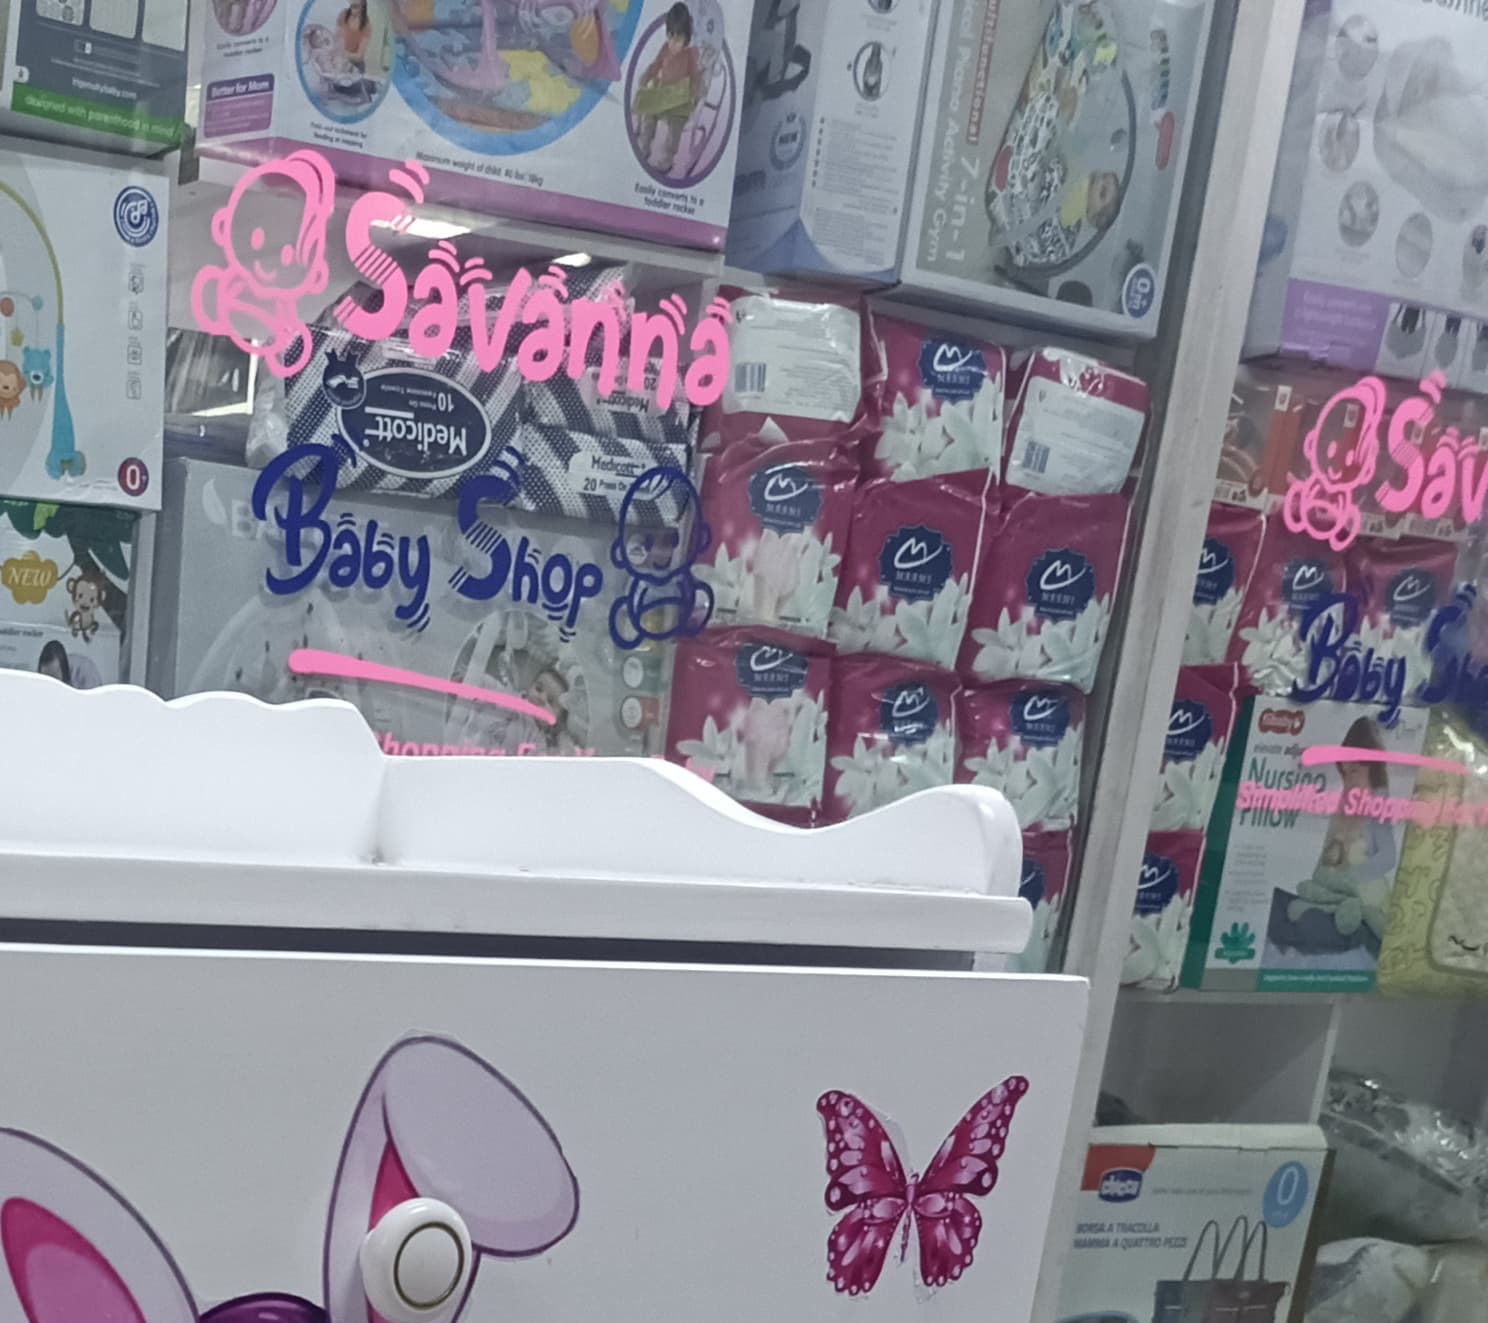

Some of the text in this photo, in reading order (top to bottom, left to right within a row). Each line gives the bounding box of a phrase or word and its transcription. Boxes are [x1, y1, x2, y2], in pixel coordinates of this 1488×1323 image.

[334, 190, 730, 408] Savanna
[365, 415, 467, 456] Medicott
[252, 443, 603, 629] Baby Shop
[8, 567, 52, 586] NEW
[1277, 1165, 1300, 1206] 0
